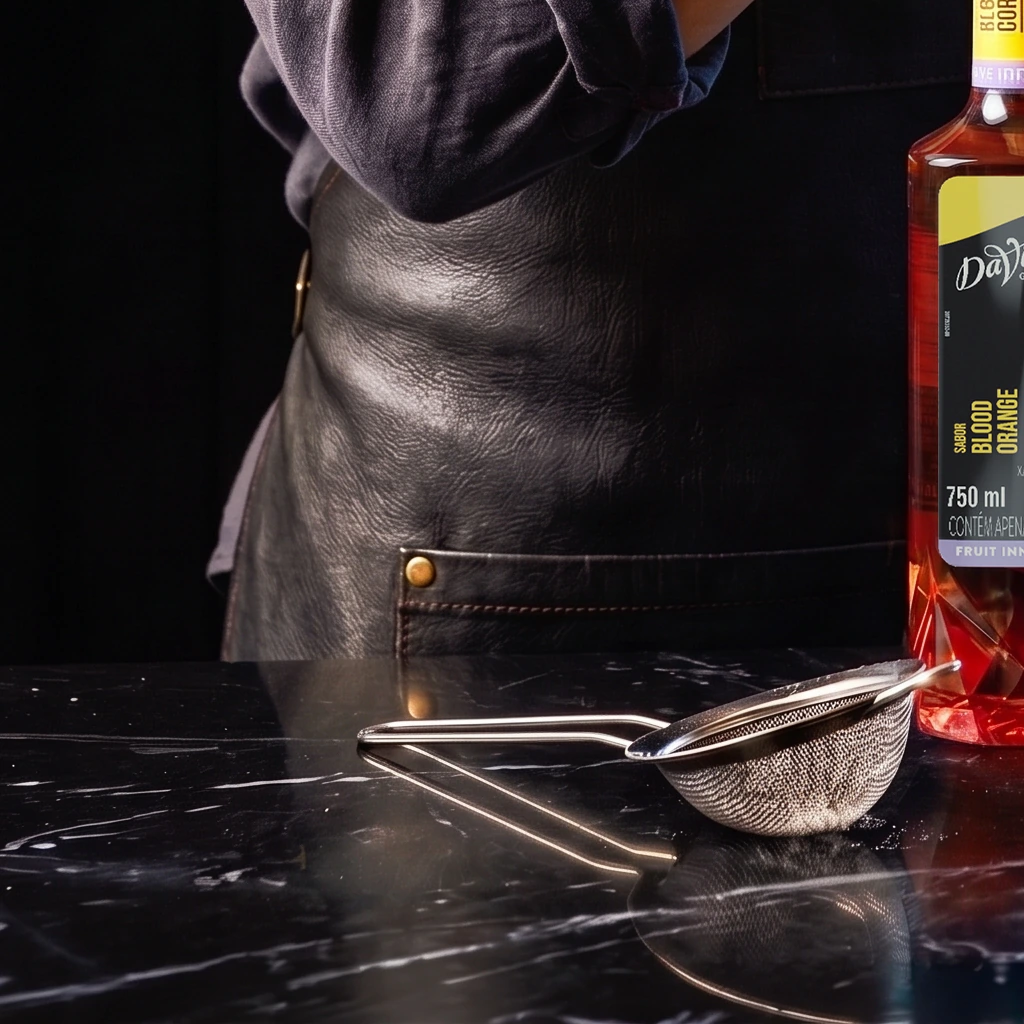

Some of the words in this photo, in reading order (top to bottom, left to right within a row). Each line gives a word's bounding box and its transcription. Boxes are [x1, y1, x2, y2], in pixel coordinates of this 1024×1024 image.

[971, 400, 993, 454] BLOOD
[996, 388, 1018, 454] ORANGE
[954, 422, 967, 453] SABOR
[946, 486, 978, 508] 750
[984, 486, 1006, 508] ml
[955, 546, 997, 556] FRUIT
